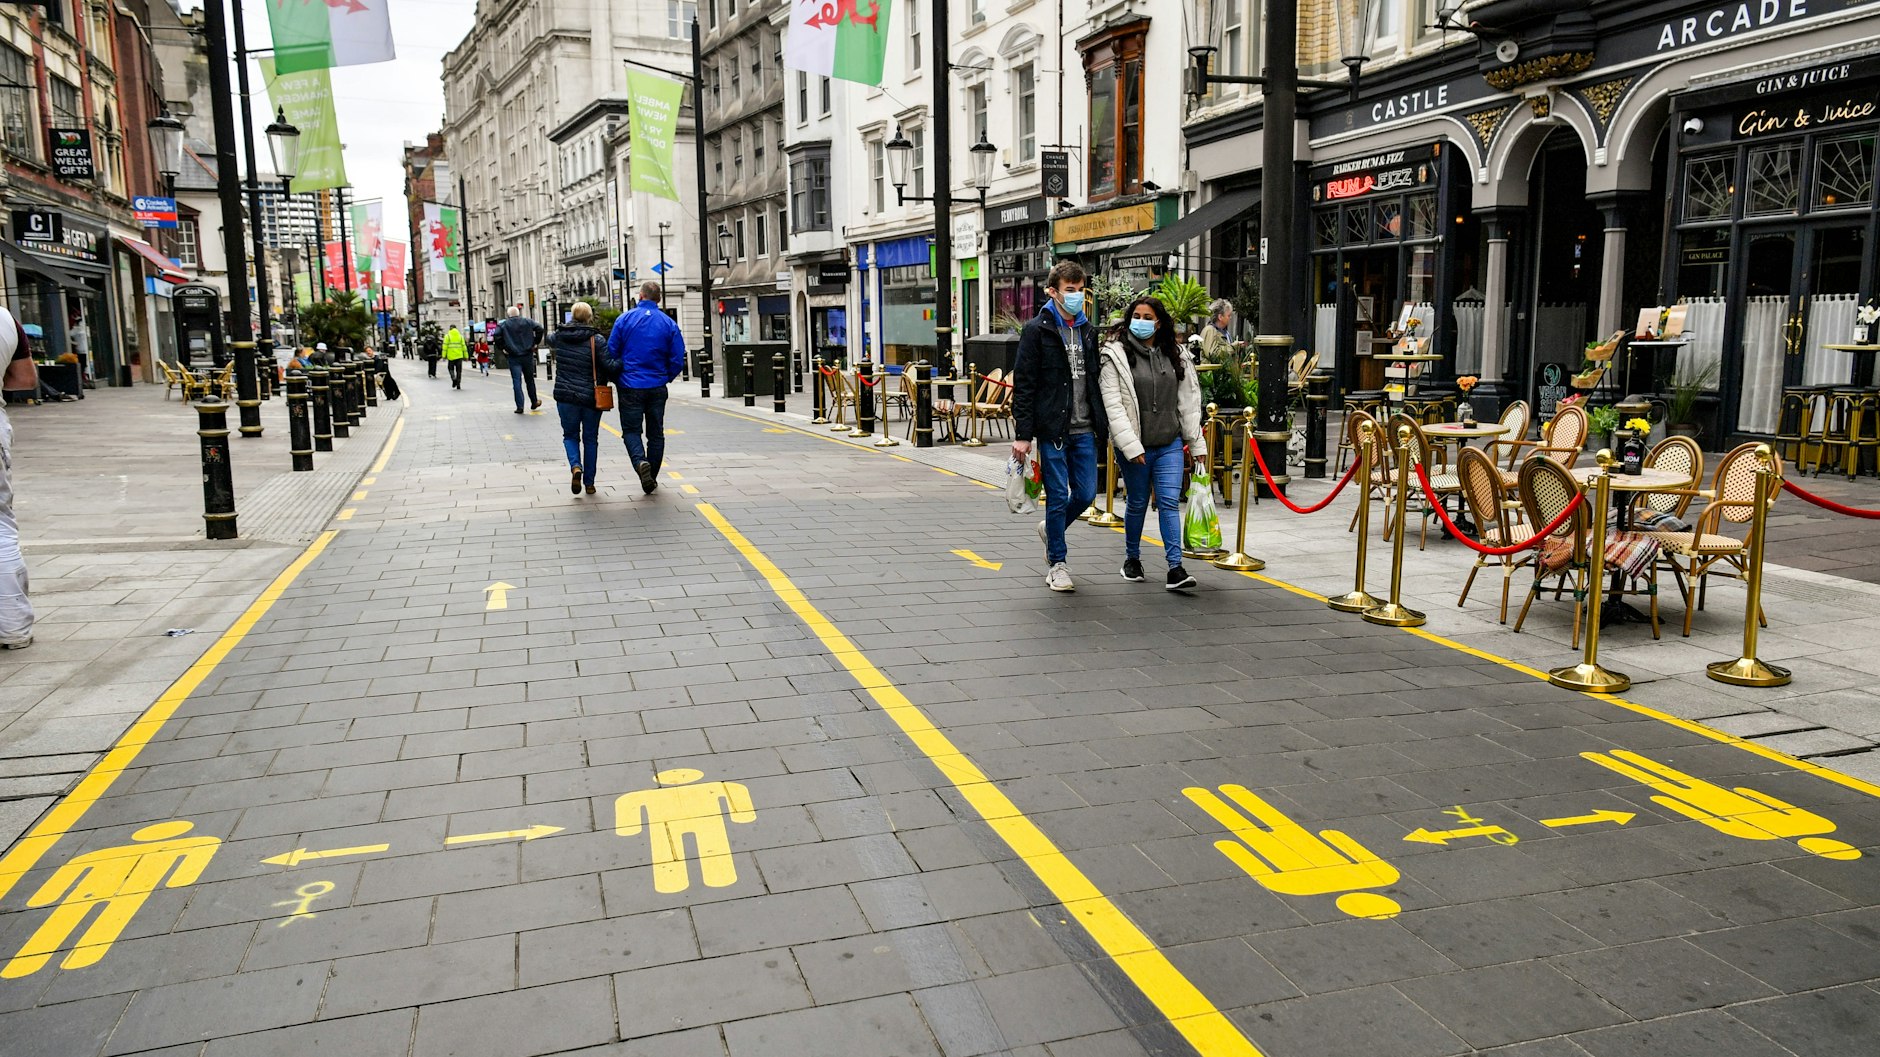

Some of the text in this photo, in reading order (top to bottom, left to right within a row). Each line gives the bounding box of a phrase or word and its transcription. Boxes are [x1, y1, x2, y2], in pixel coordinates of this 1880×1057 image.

[1657, 0, 1808, 50] ARCADE
[1756, 64, 1851, 95] GIN & JUICE
[1371, 84, 1448, 122] CASTLE
[1739, 100, 1877, 136] Gin & Juice
[54, 157, 92, 166] WELSH
[55, 148, 88, 157] GREAT
[1333, 151, 1405, 175] BARKER RUM & FIZZ
[60, 166, 89, 175] GIFTS
[1327, 167, 1414, 199] RUM & FIZZ
[30, 213, 43, 231] C
[1701, 251, 1724, 260] PALACE
